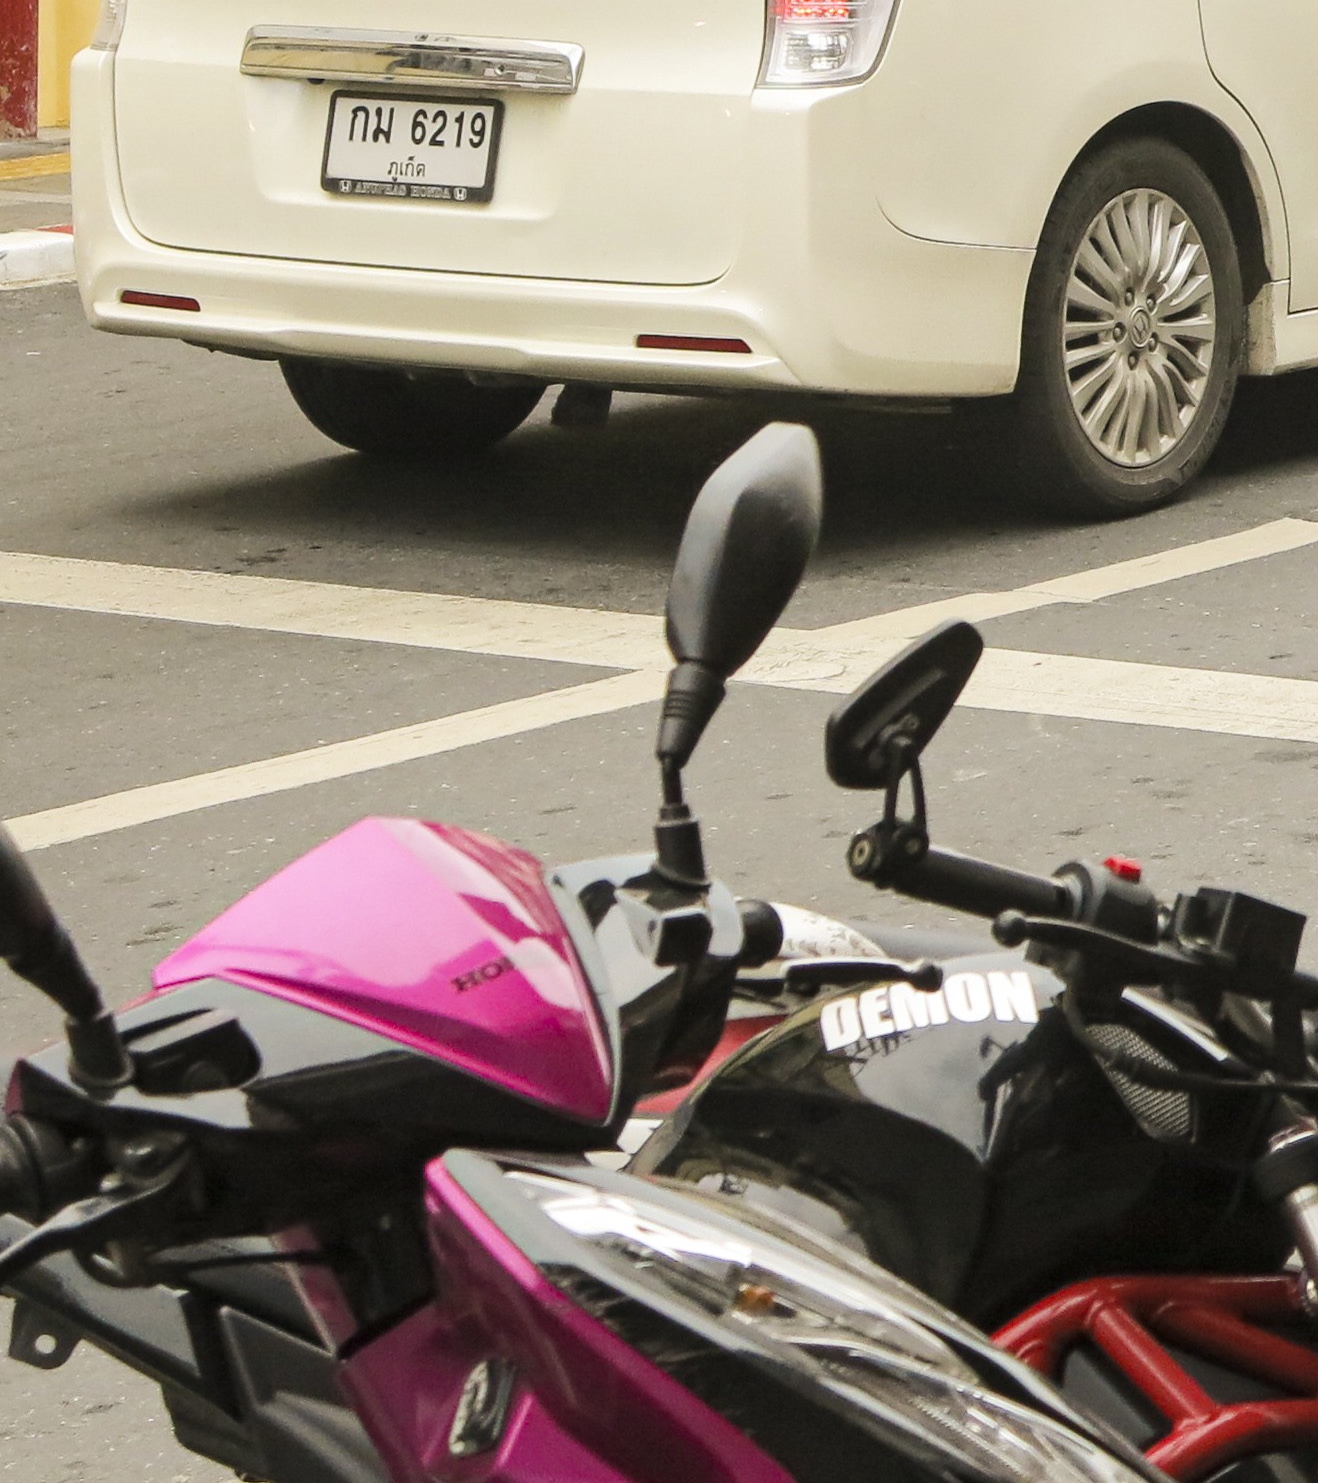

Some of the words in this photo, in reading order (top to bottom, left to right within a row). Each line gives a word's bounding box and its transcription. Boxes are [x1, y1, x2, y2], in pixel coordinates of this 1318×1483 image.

[349, 105, 395, 144] กม
[410, 108, 487, 149] 6219
[387, 155, 426, 183] ภูเก็ต
[820, 971, 1040, 1052] DEMON
